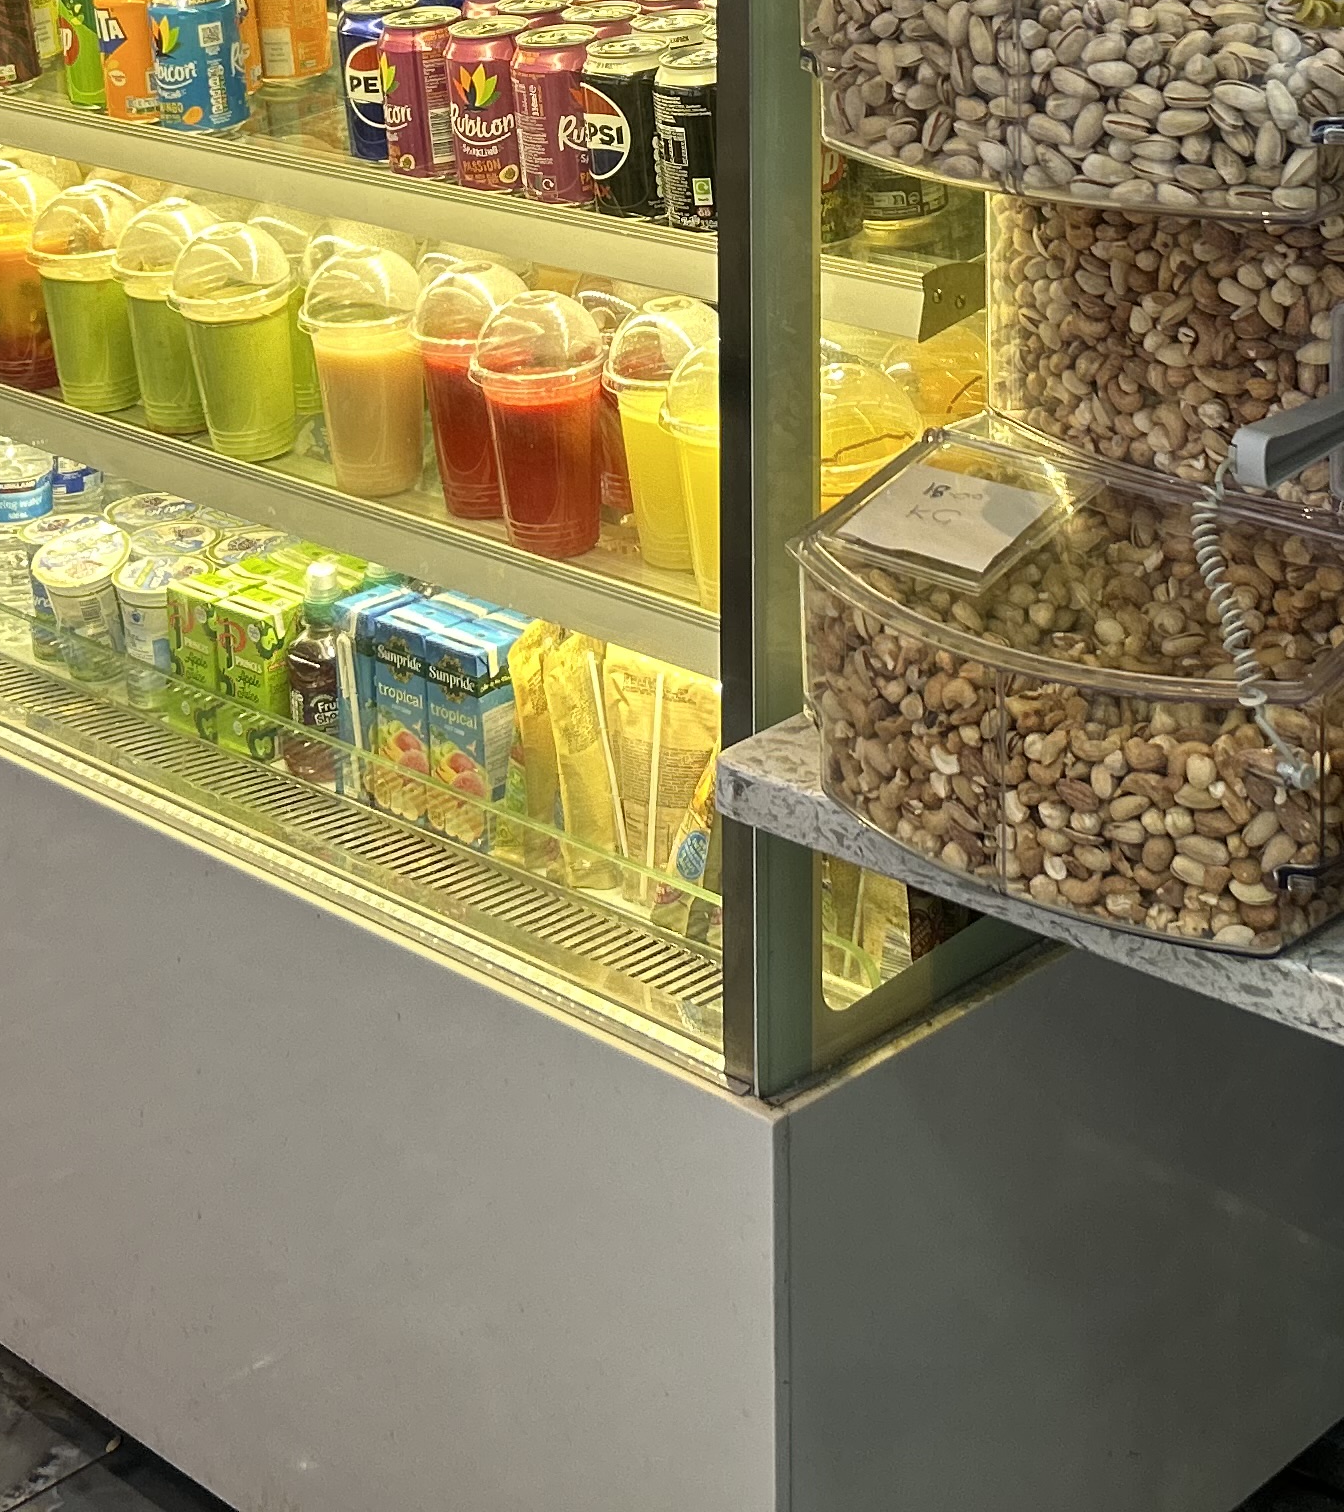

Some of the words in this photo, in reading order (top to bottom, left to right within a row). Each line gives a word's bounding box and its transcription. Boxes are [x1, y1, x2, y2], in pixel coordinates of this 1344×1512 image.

[157, 61, 198, 83] bicon
[450, 101, 515, 139] Rubicon
[587, 122, 625, 147] PSI
[462, 157, 502, 172] PASSION
[184, 651, 207, 669] Apple
[377, 644, 422, 674] Sunpride
[235, 670, 261, 688] Apple
[428, 664, 476, 694] Sunpride
[317, 701, 340, 714] Frui
[378, 680, 423, 710] tropical
[430, 702, 478, 730] tropical
